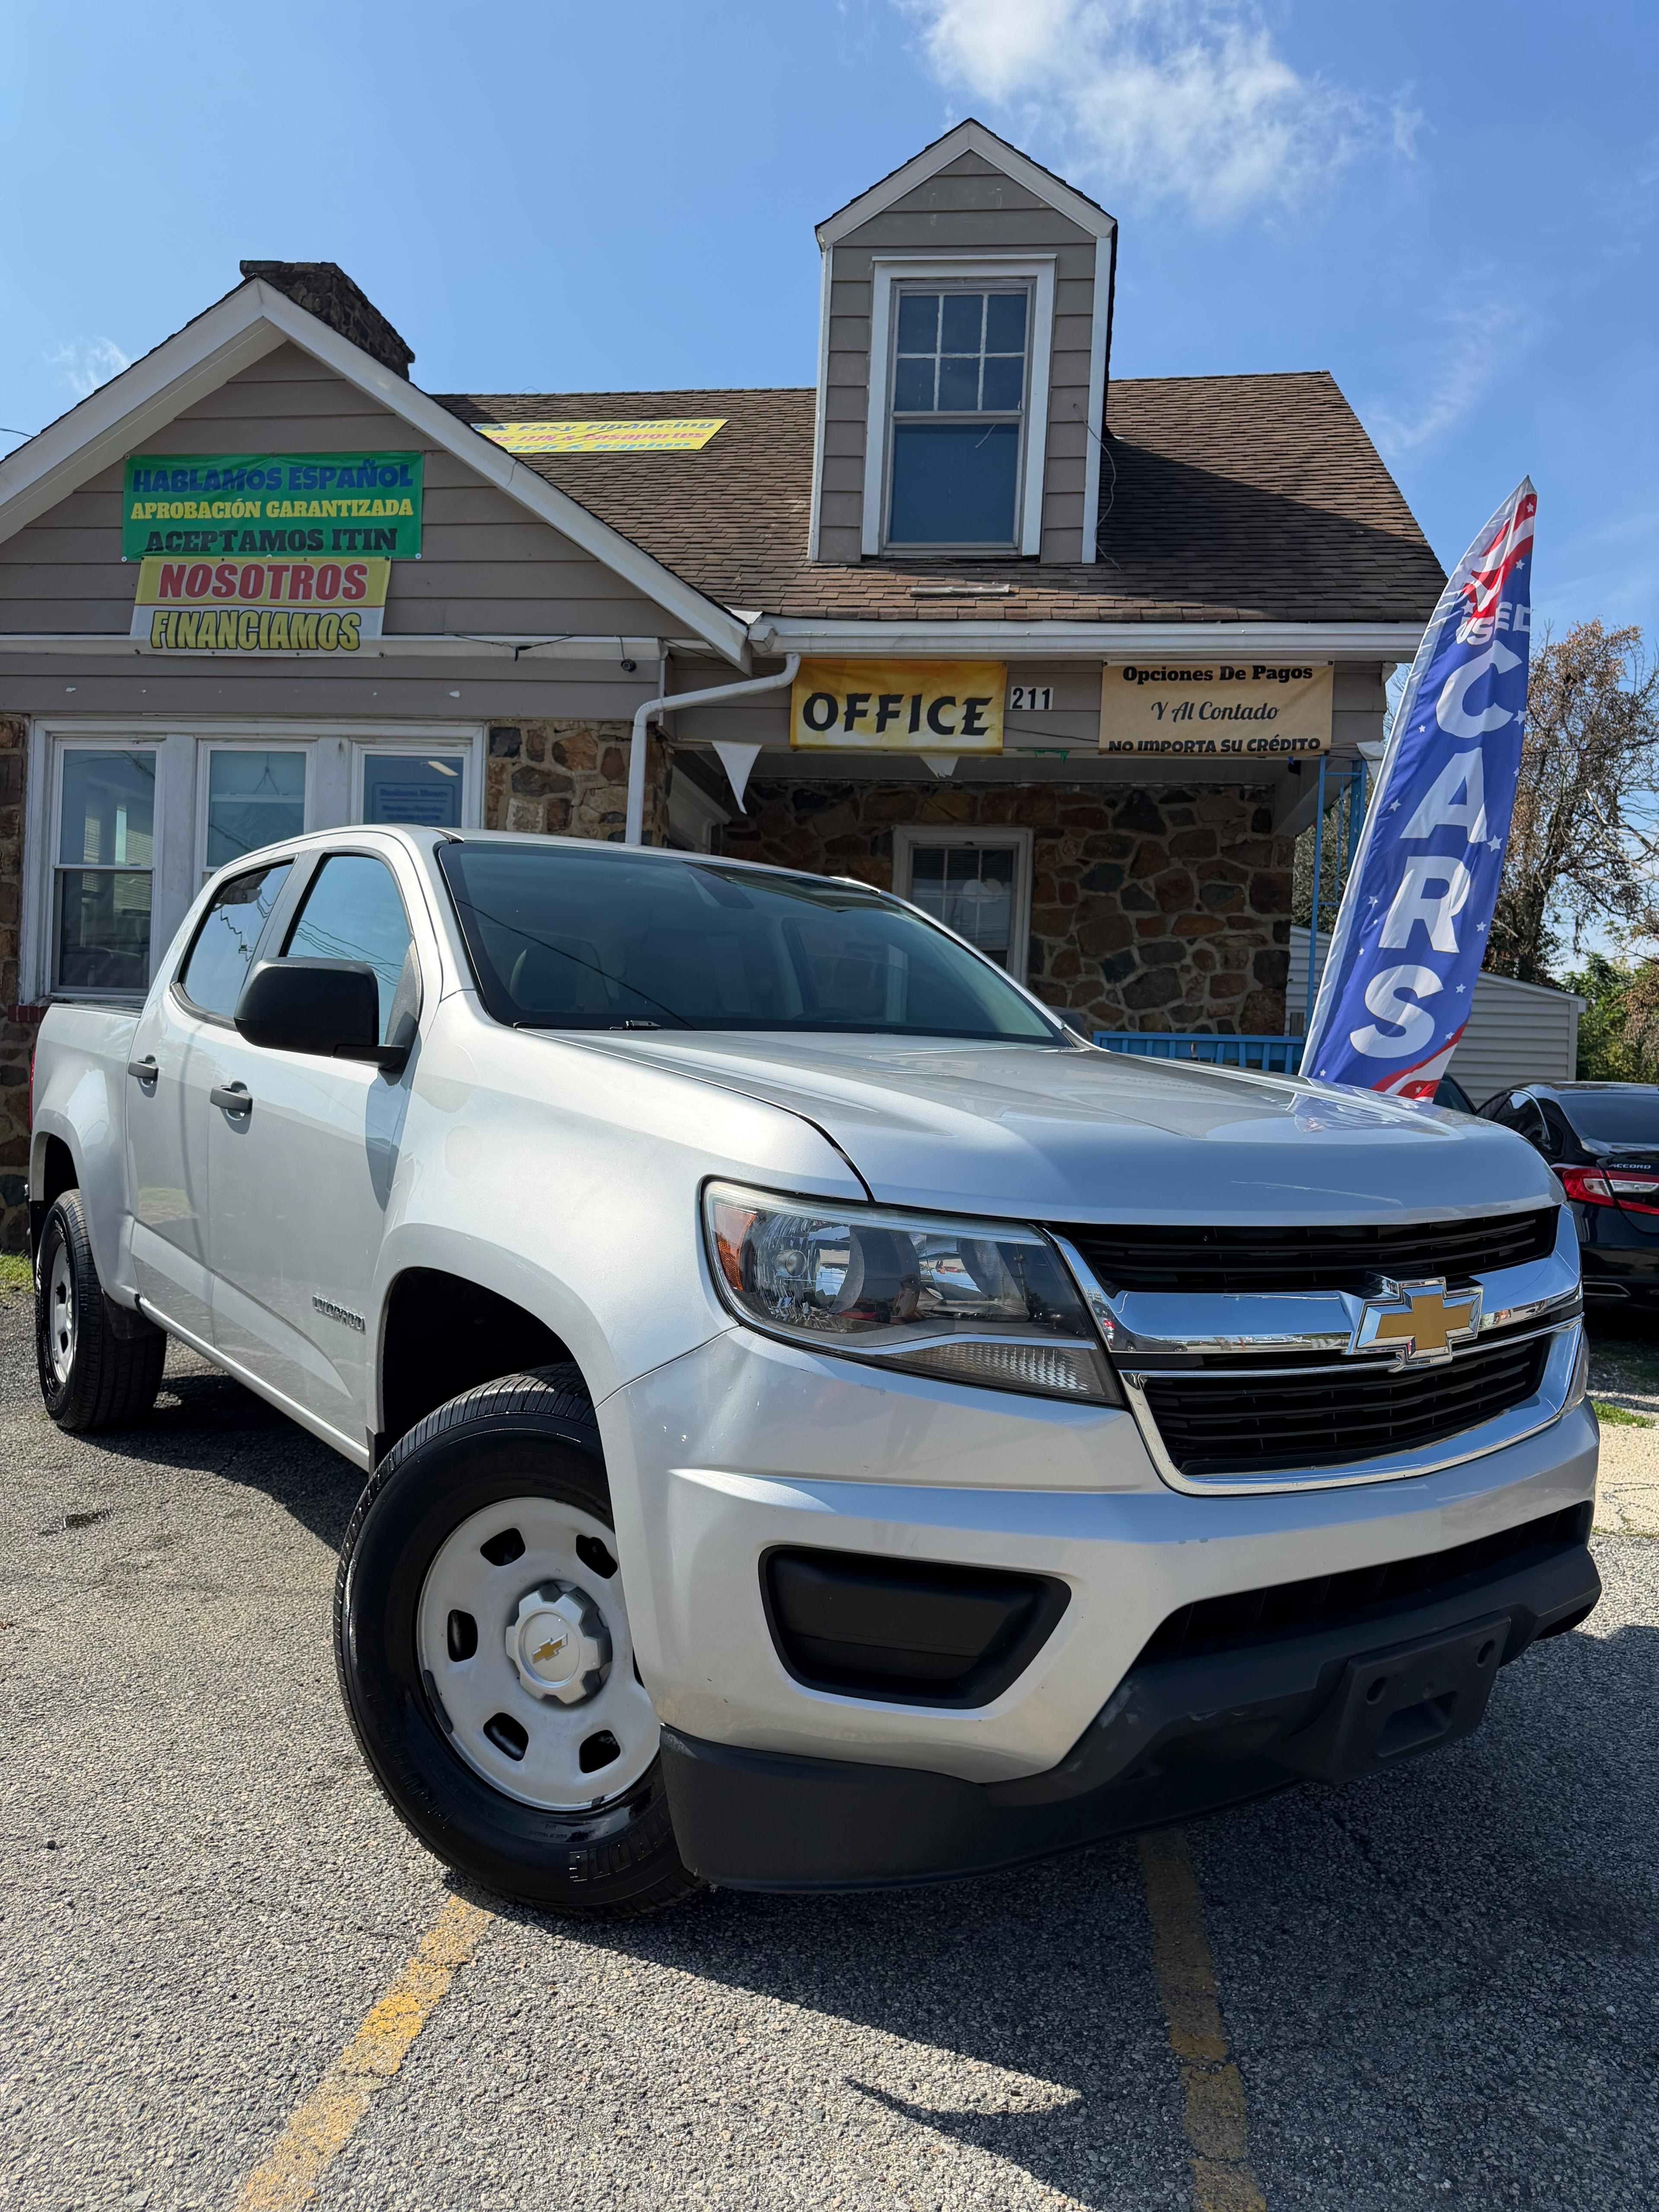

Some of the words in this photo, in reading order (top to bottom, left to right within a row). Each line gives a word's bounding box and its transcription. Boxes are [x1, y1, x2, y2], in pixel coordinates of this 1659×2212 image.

[586, 422, 715, 430] Financing
[133, 468, 282, 492] HABLAMOS
[288, 459, 413, 491] ESPAÑOL
[131, 499, 261, 519] APROBACIÓN
[266, 499, 413, 518] GARANTIZADA
[145, 530, 324, 552] ACEPTAMOS
[332, 528, 397, 550] ITIN
[158, 563, 369, 601] NOSOTROS
[150, 610, 361, 651] FINANCIAMOS
[1123, 666, 1213, 685] Opciones
[1219, 666, 1246, 681] De
[1252, 665, 1313, 683] Pagos
[1012, 688, 1051, 710] 211
[803, 692, 994, 736] OFFICE
[1151, 702, 1169, 721] Y
[1172, 702, 1194, 722] Al
[1198, 701, 1280, 721] Contado
[1109, 741, 1134, 752] NO
[1350, 640, 1522, 1058] CARS
